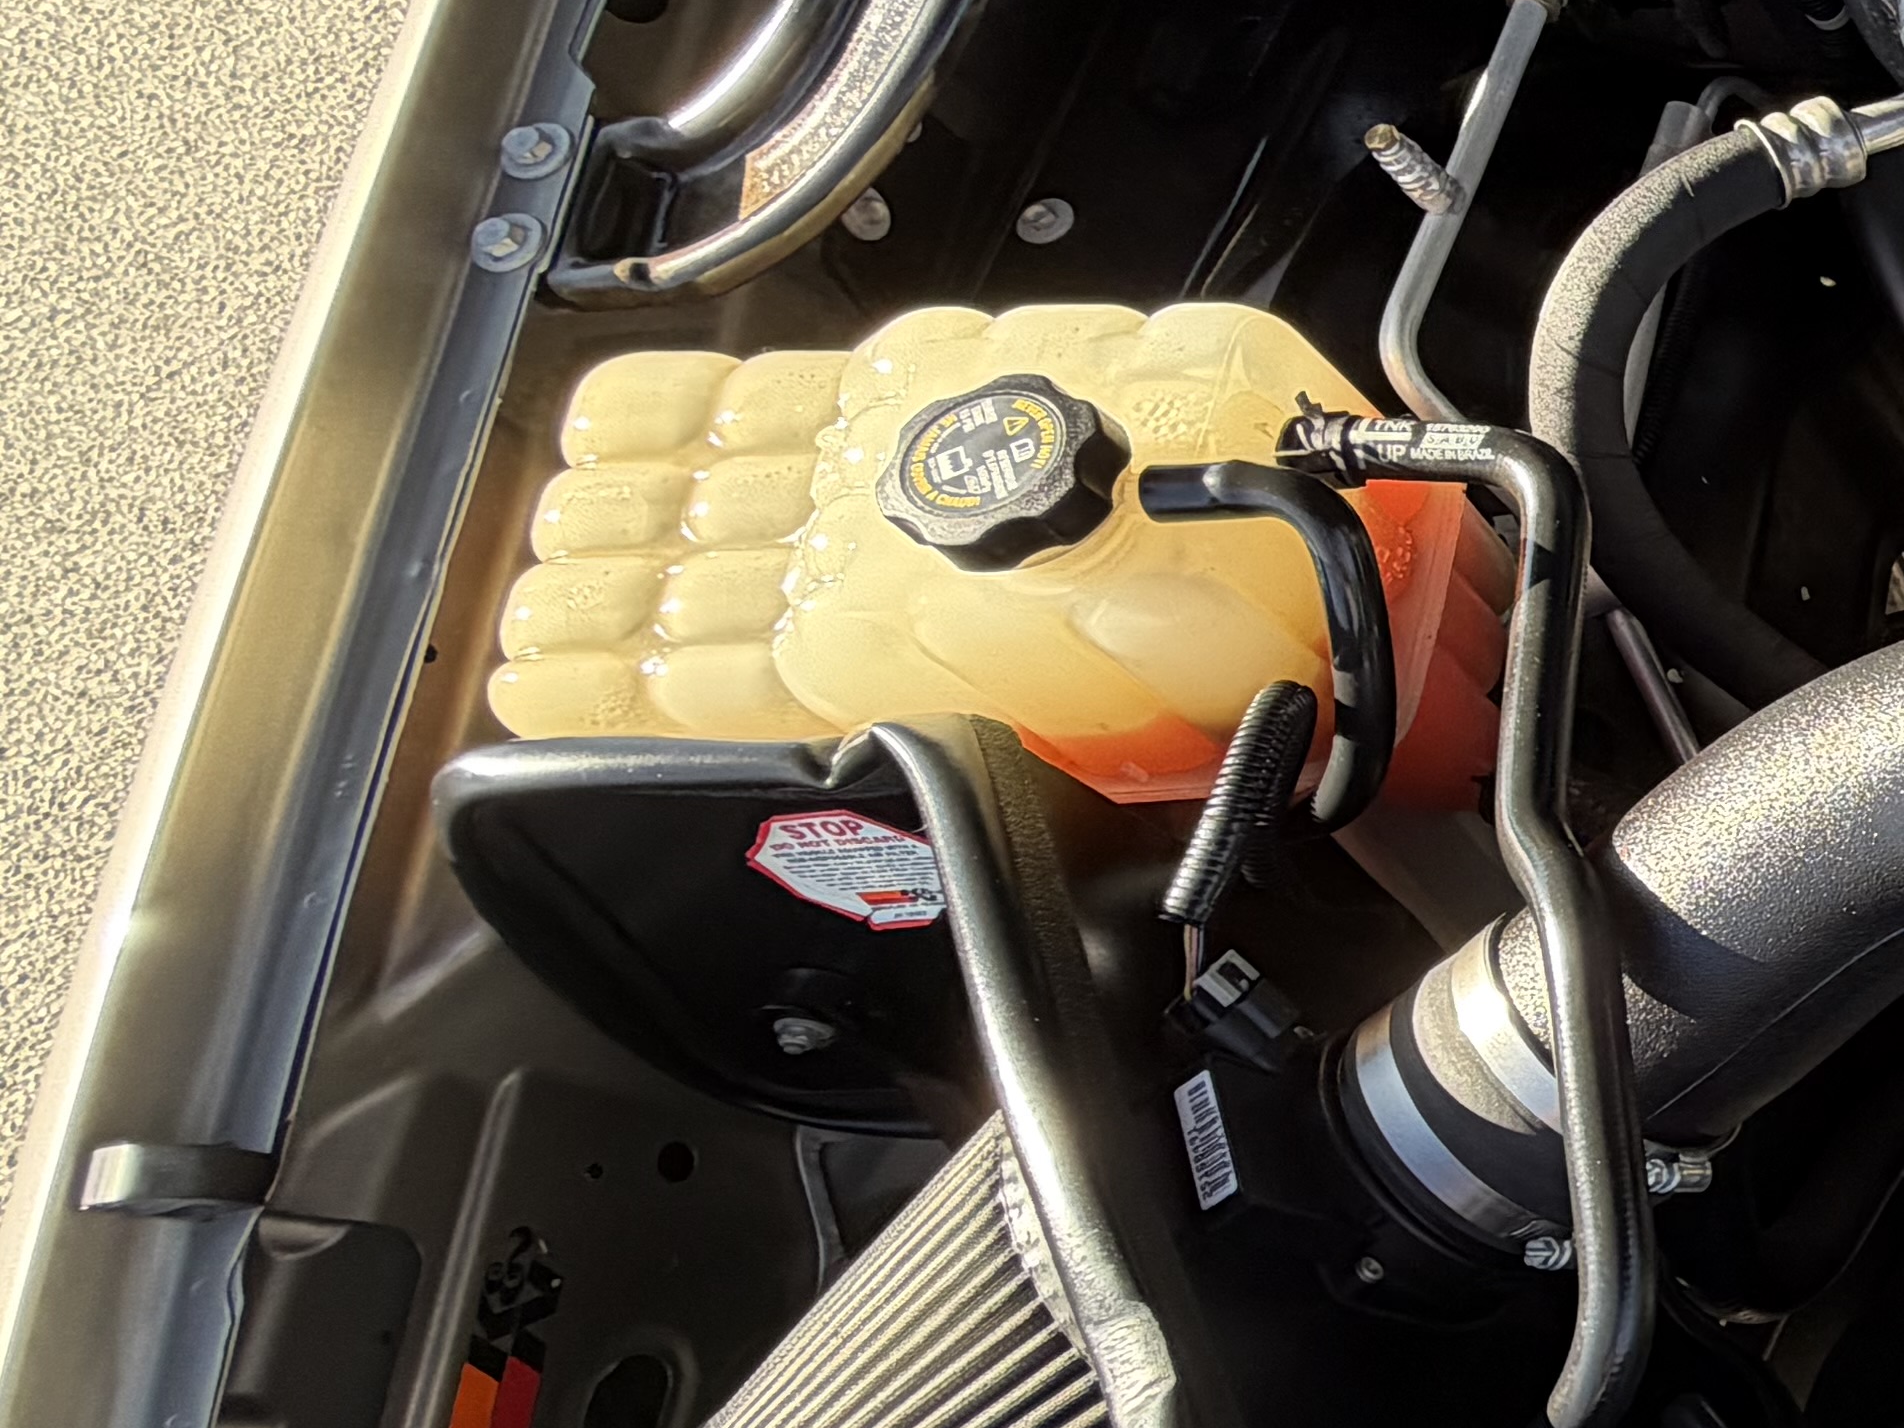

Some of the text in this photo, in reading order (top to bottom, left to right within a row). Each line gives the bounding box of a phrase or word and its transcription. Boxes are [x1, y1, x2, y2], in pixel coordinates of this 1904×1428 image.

[1377, 443, 1407, 462] UP
[1410, 448, 1444, 460] MADE
[779, 819, 865, 840] STOP
